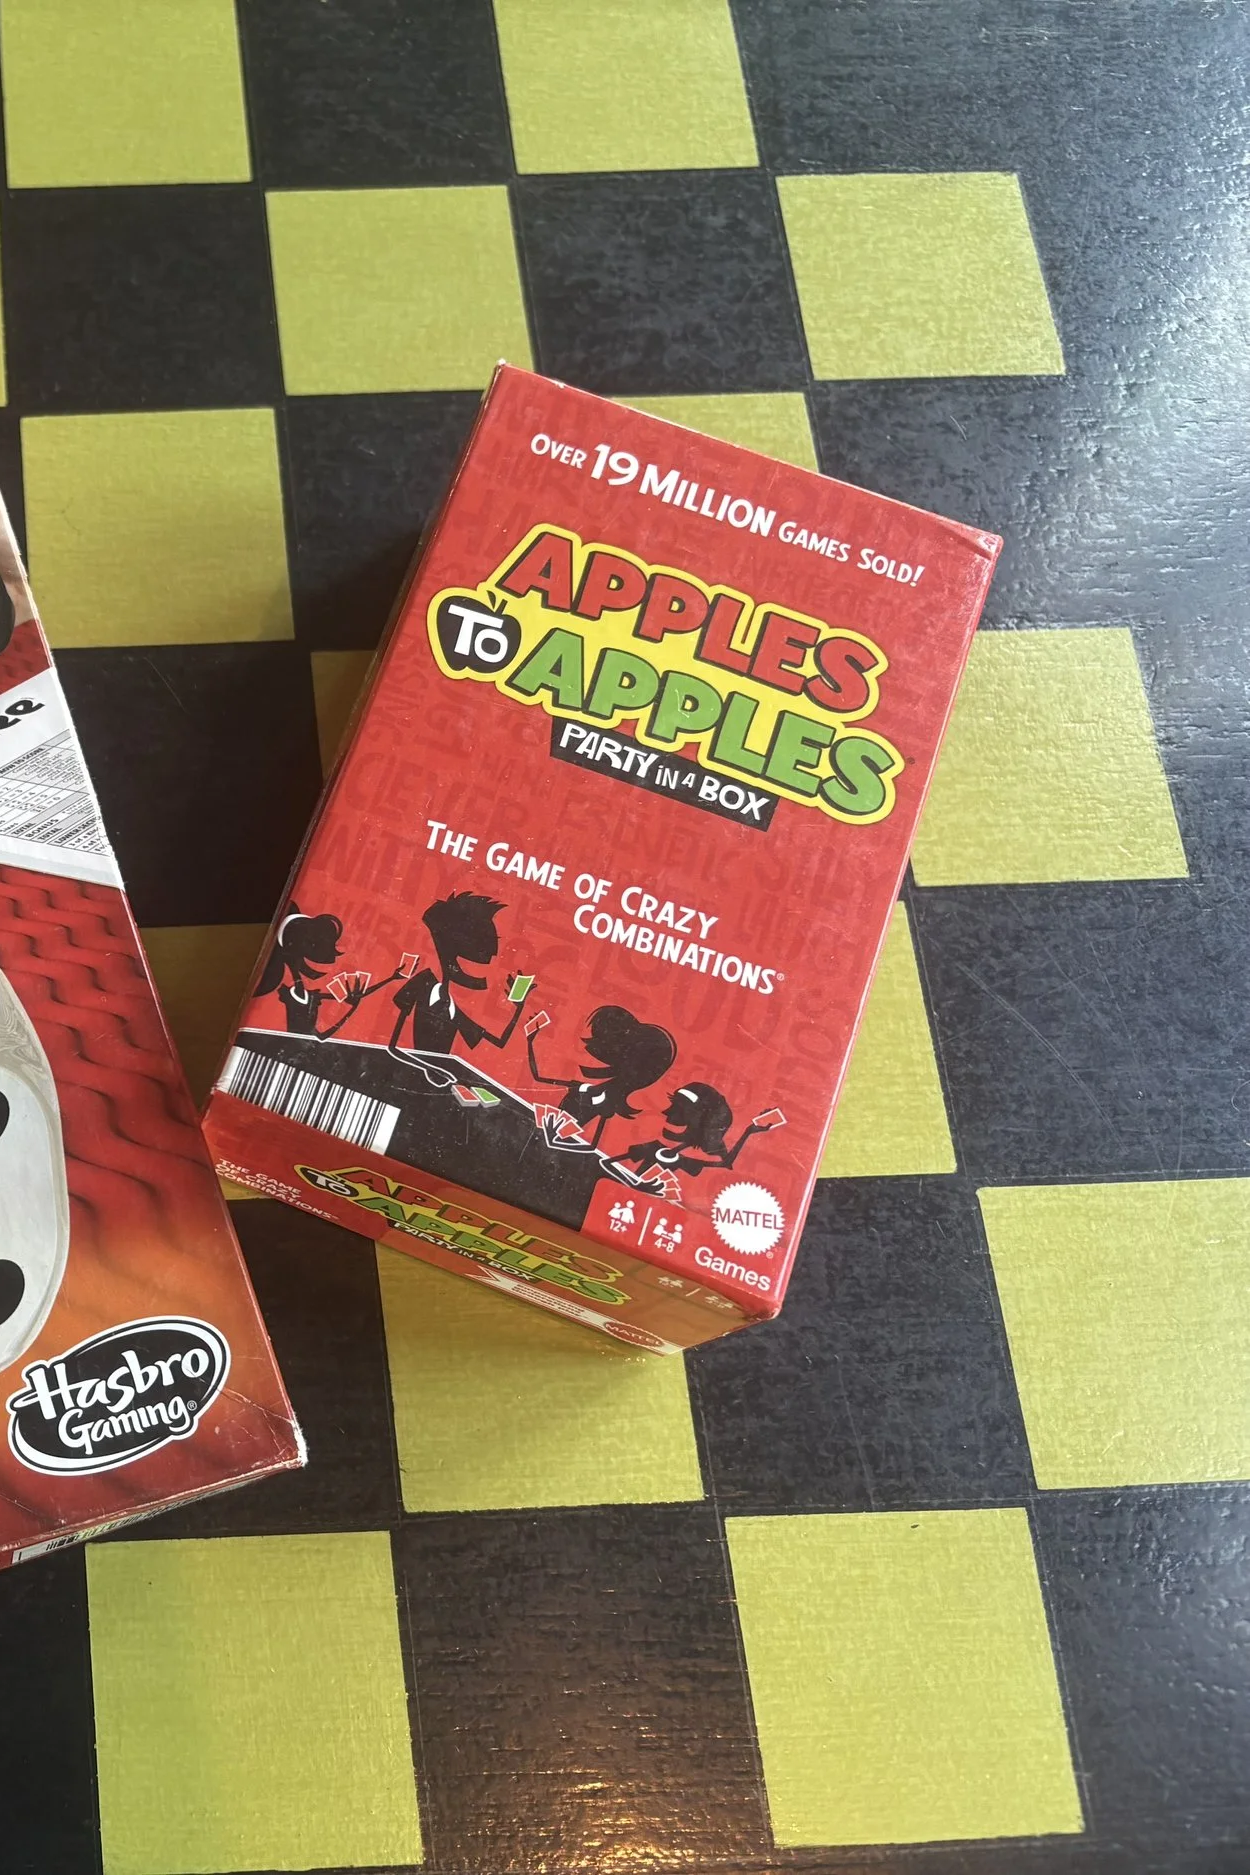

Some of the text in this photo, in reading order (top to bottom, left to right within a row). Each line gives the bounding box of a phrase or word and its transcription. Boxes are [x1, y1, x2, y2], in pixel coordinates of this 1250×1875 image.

[530, 433, 926, 588] OVER 19 MILLION GAMES SOLD!
[494, 531, 880, 714] APPLES
[506, 627, 896, 816] APPLES
[559, 722, 659, 779] PARTY
[681, 772, 696, 788] A
[698, 775, 770, 821] BOX
[25, 818, 60, 838] BONUS
[425, 820, 479, 862] THE
[486, 842, 566, 891] GAME
[573, 873, 613, 904] OF
[620, 886, 719, 940] CRAZY
[216, 1163, 302, 1199] OF CRAZY
[219, 1157, 302, 1194] THE GAME
[340, 1168, 619, 1280] APPLES
[355, 1196, 624, 1303] APPLES
[609, 1218, 629, 1234] 12+
[654, 1237, 676, 1254] 4-8
[714, 1207, 785, 1231] MATTEL
[393, 1222, 456, 1251] PARTY
[487, 1259, 536, 1281] BOX
[694, 1246, 772, 1292] Games
[604, 1323, 664, 1347] MATTEL
[11, 1348, 210, 1421] Hasbro
[58, 1392, 190, 1455] Gaming
